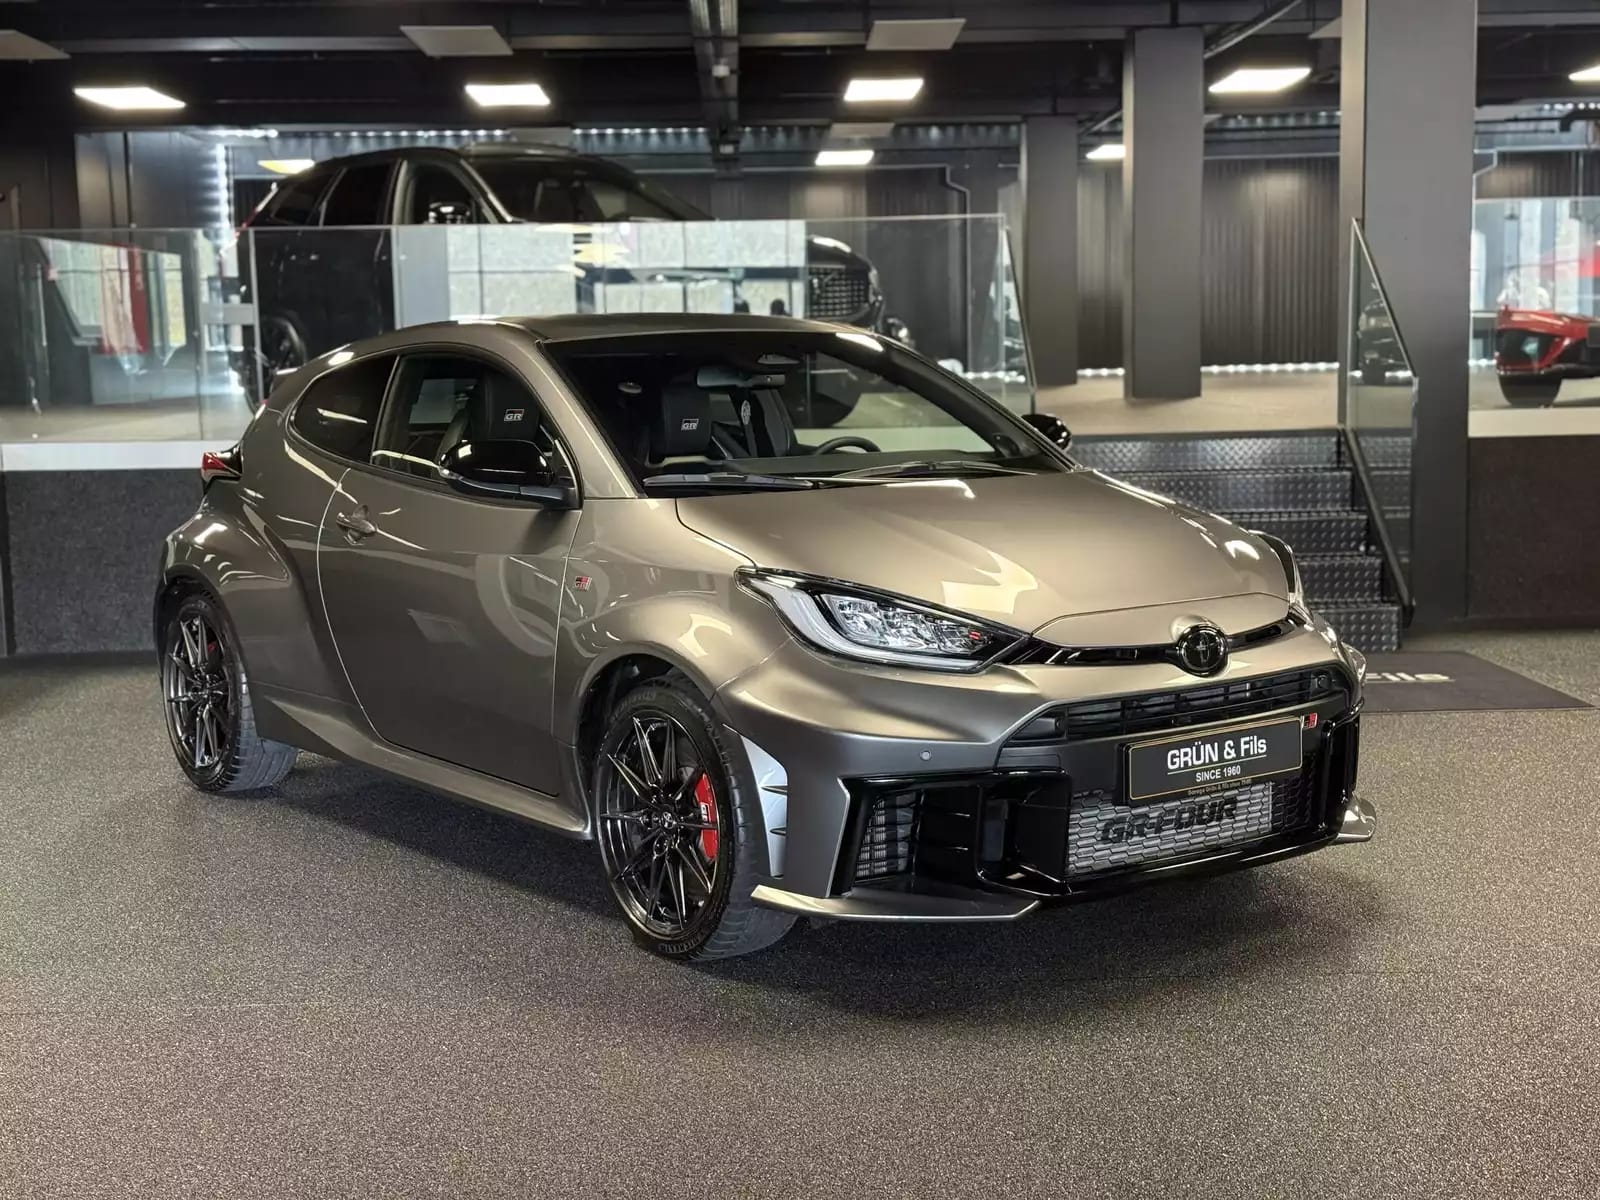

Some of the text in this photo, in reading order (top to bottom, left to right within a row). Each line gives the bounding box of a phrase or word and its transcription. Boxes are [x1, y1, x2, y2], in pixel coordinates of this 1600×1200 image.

[1167, 735, 1267, 770] GRÜN & Fils
[1195, 765, 1240, 782] SINCE 1960
